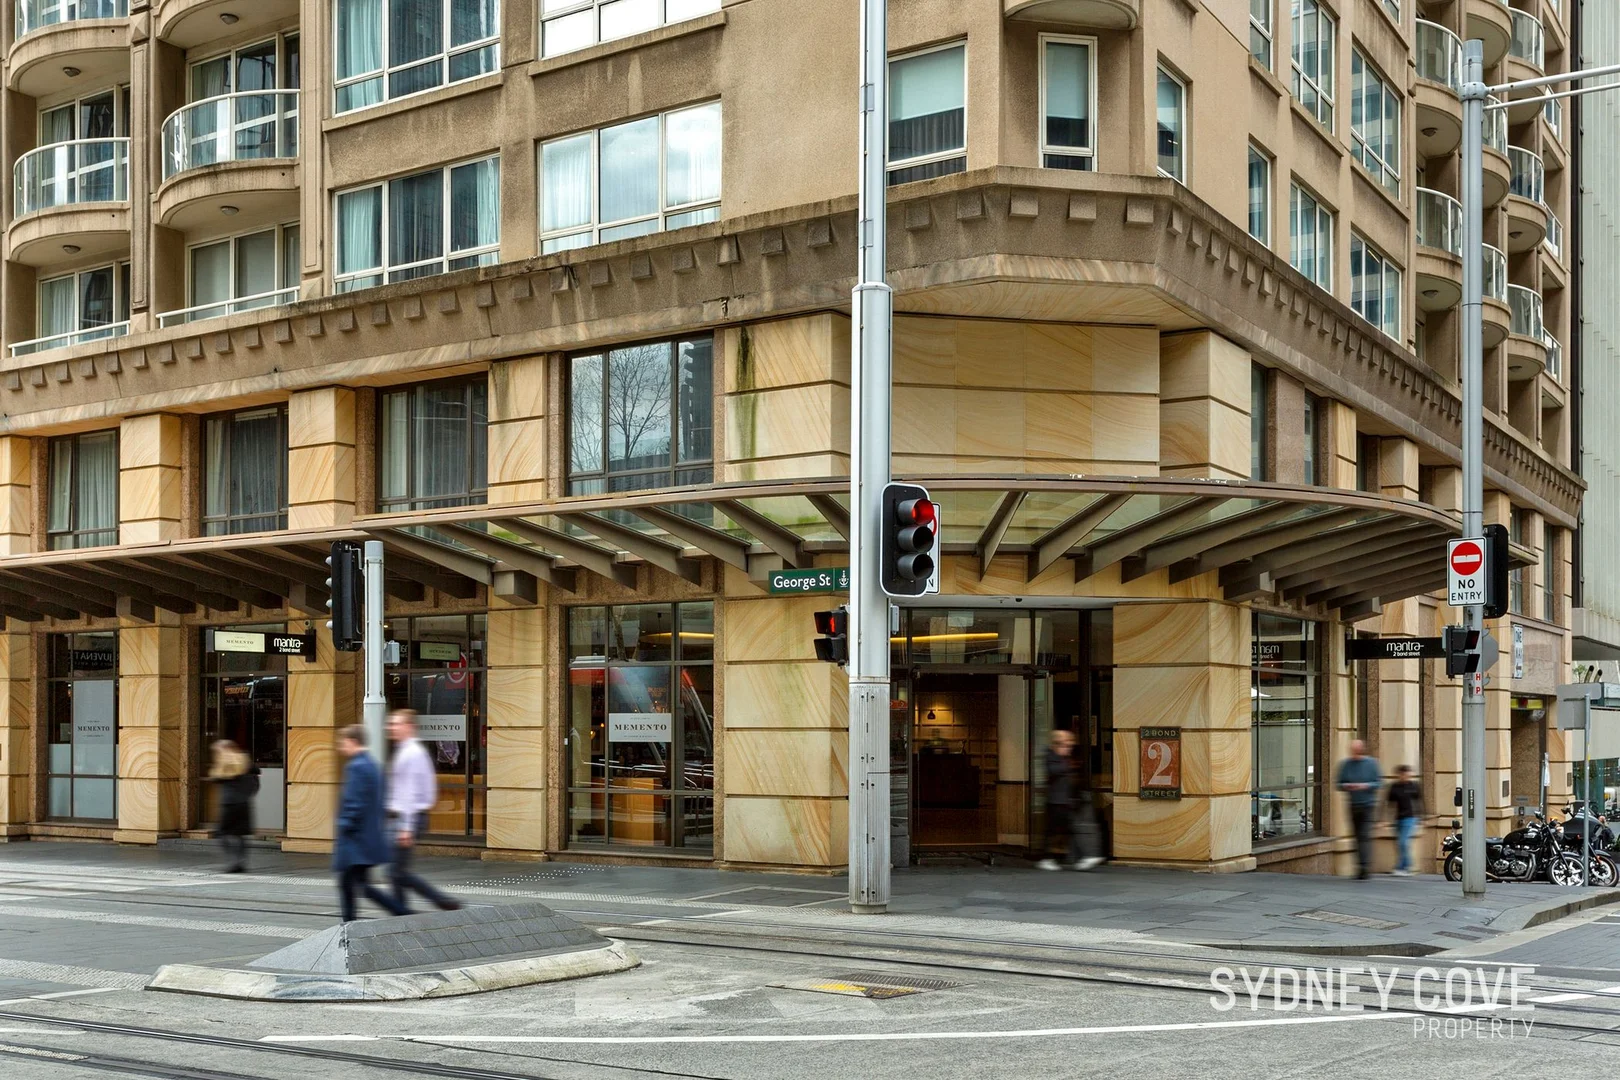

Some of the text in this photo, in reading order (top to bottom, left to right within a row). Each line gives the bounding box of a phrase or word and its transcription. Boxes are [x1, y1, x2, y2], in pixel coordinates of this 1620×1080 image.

[774, 573, 831, 590] George St
[1458, 578, 1475, 589] NO
[1451, 591, 1482, 601] ENTRY
[614, 723, 667, 731] MEMENTO
[1147, 741, 1172, 786] 2
